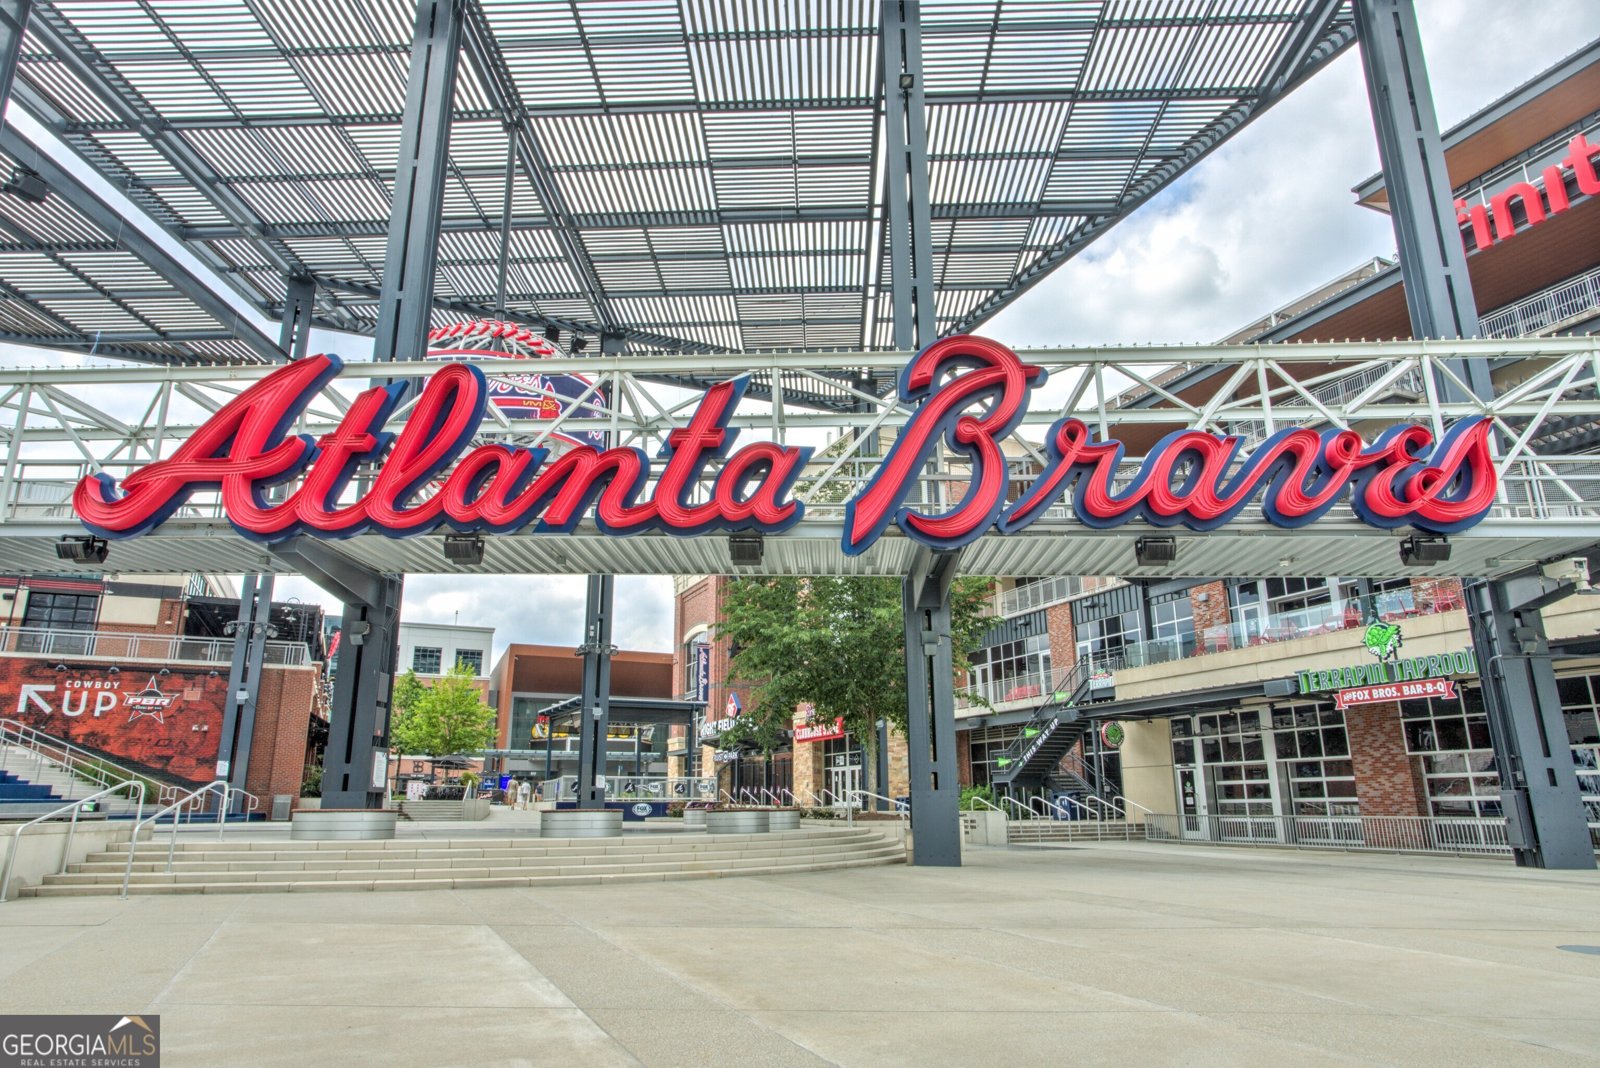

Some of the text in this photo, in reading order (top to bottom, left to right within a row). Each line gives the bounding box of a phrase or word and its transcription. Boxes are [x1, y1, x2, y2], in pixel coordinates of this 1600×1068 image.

[73, 335, 1498, 557] Atlanta Braves
[65, 680, 121, 689] COWBOY
[1294, 664, 1388, 694] TERRAPIN
[1352, 690, 1370, 701] FOX
[1372, 685, 1401, 699] BROS.
[1403, 682, 1446, 696] BAR-B-Q
[61, 690, 118, 717] UP
[126, 697, 171, 706] PBR
[1023, 718, 1059, 762] THIS WAY UP
